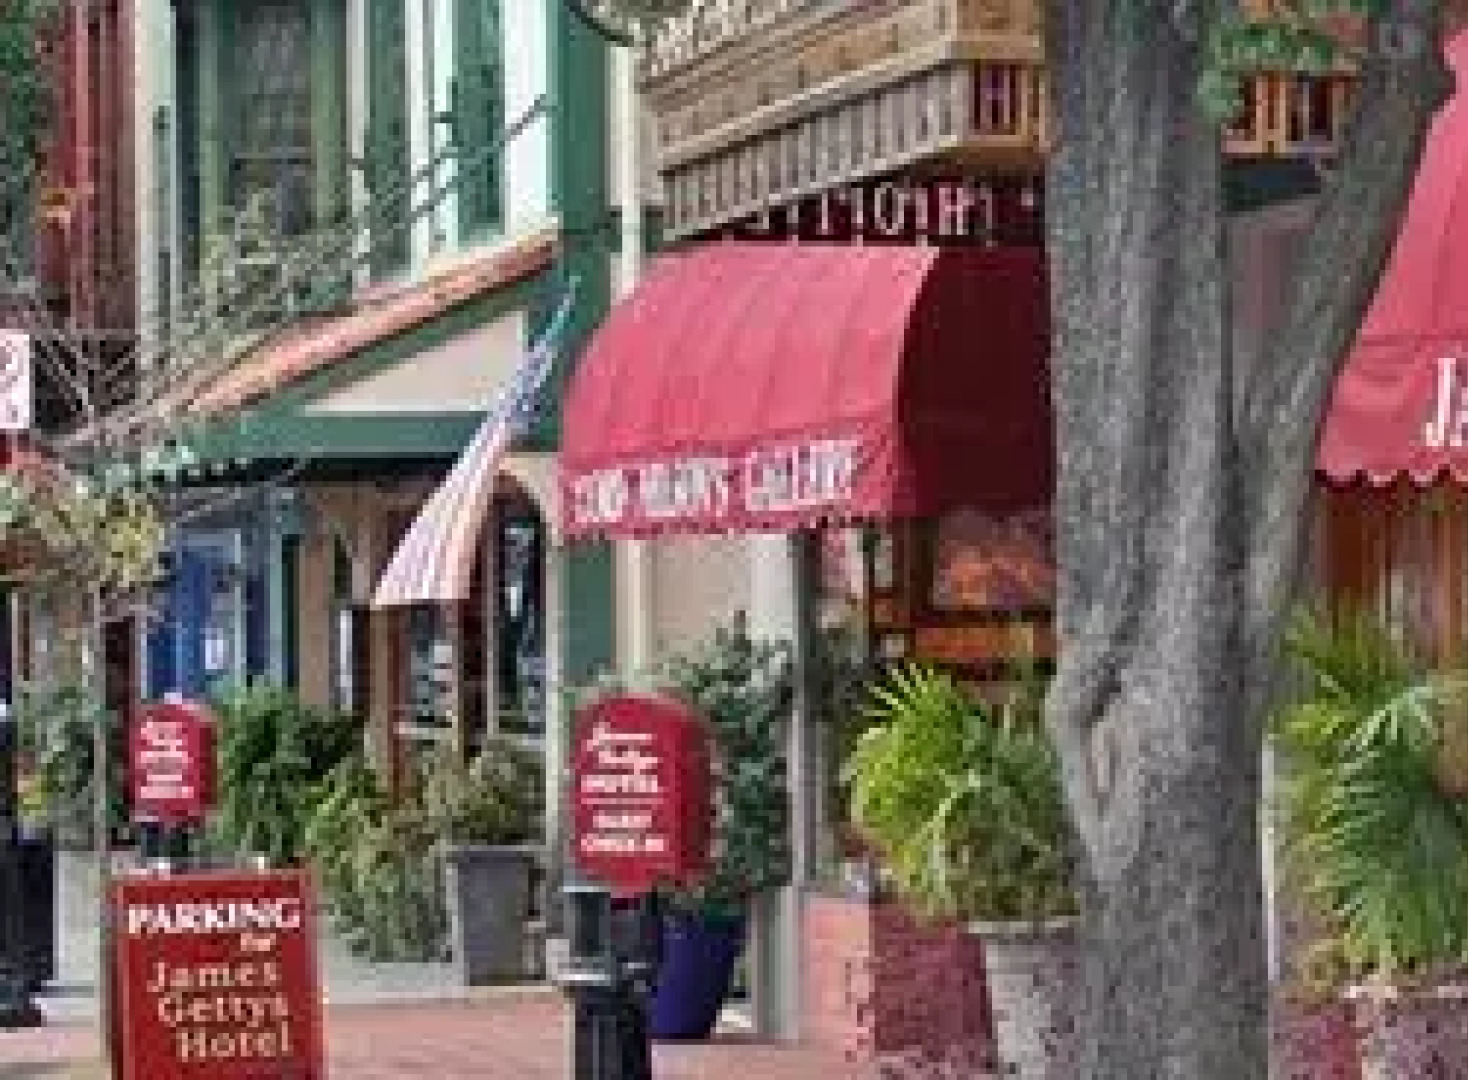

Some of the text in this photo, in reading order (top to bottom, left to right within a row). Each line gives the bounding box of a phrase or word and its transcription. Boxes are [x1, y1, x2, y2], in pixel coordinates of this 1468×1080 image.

[128, 898, 301, 936] PARKING
[146, 962, 281, 993] James
[156, 991, 290, 1029] Gettys
[175, 1021, 294, 1063] Hotel
